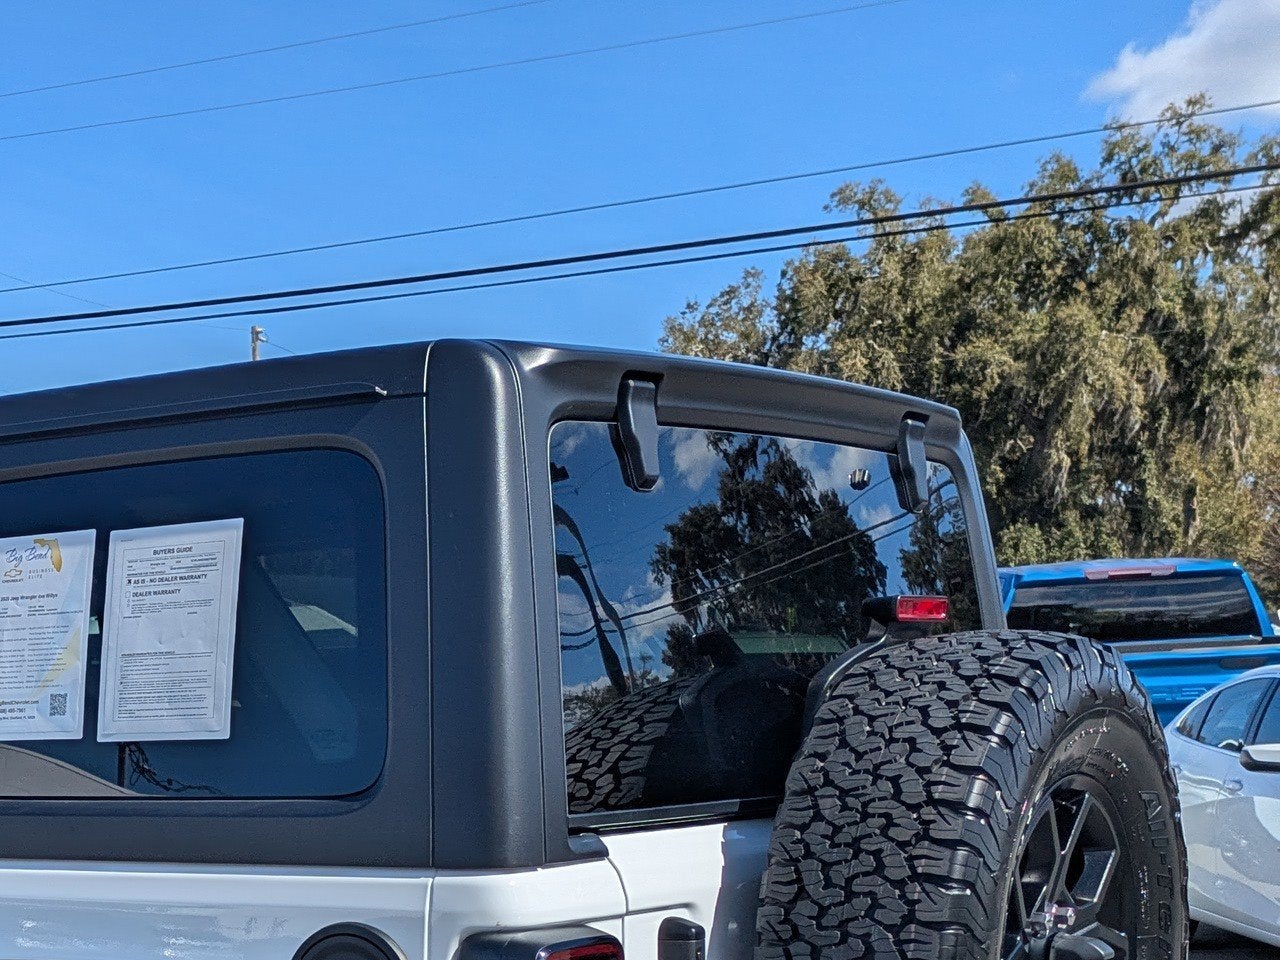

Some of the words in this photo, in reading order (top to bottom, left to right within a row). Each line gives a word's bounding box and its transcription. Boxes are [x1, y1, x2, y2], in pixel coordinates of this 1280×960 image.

[152, 548, 176, 556] BUYERS
[157, 575, 179, 583] DEALER
[179, 573, 208, 581] WARRANTY
[132, 590, 152, 598] DEALER
[152, 588, 181, 596] WARRANTY
